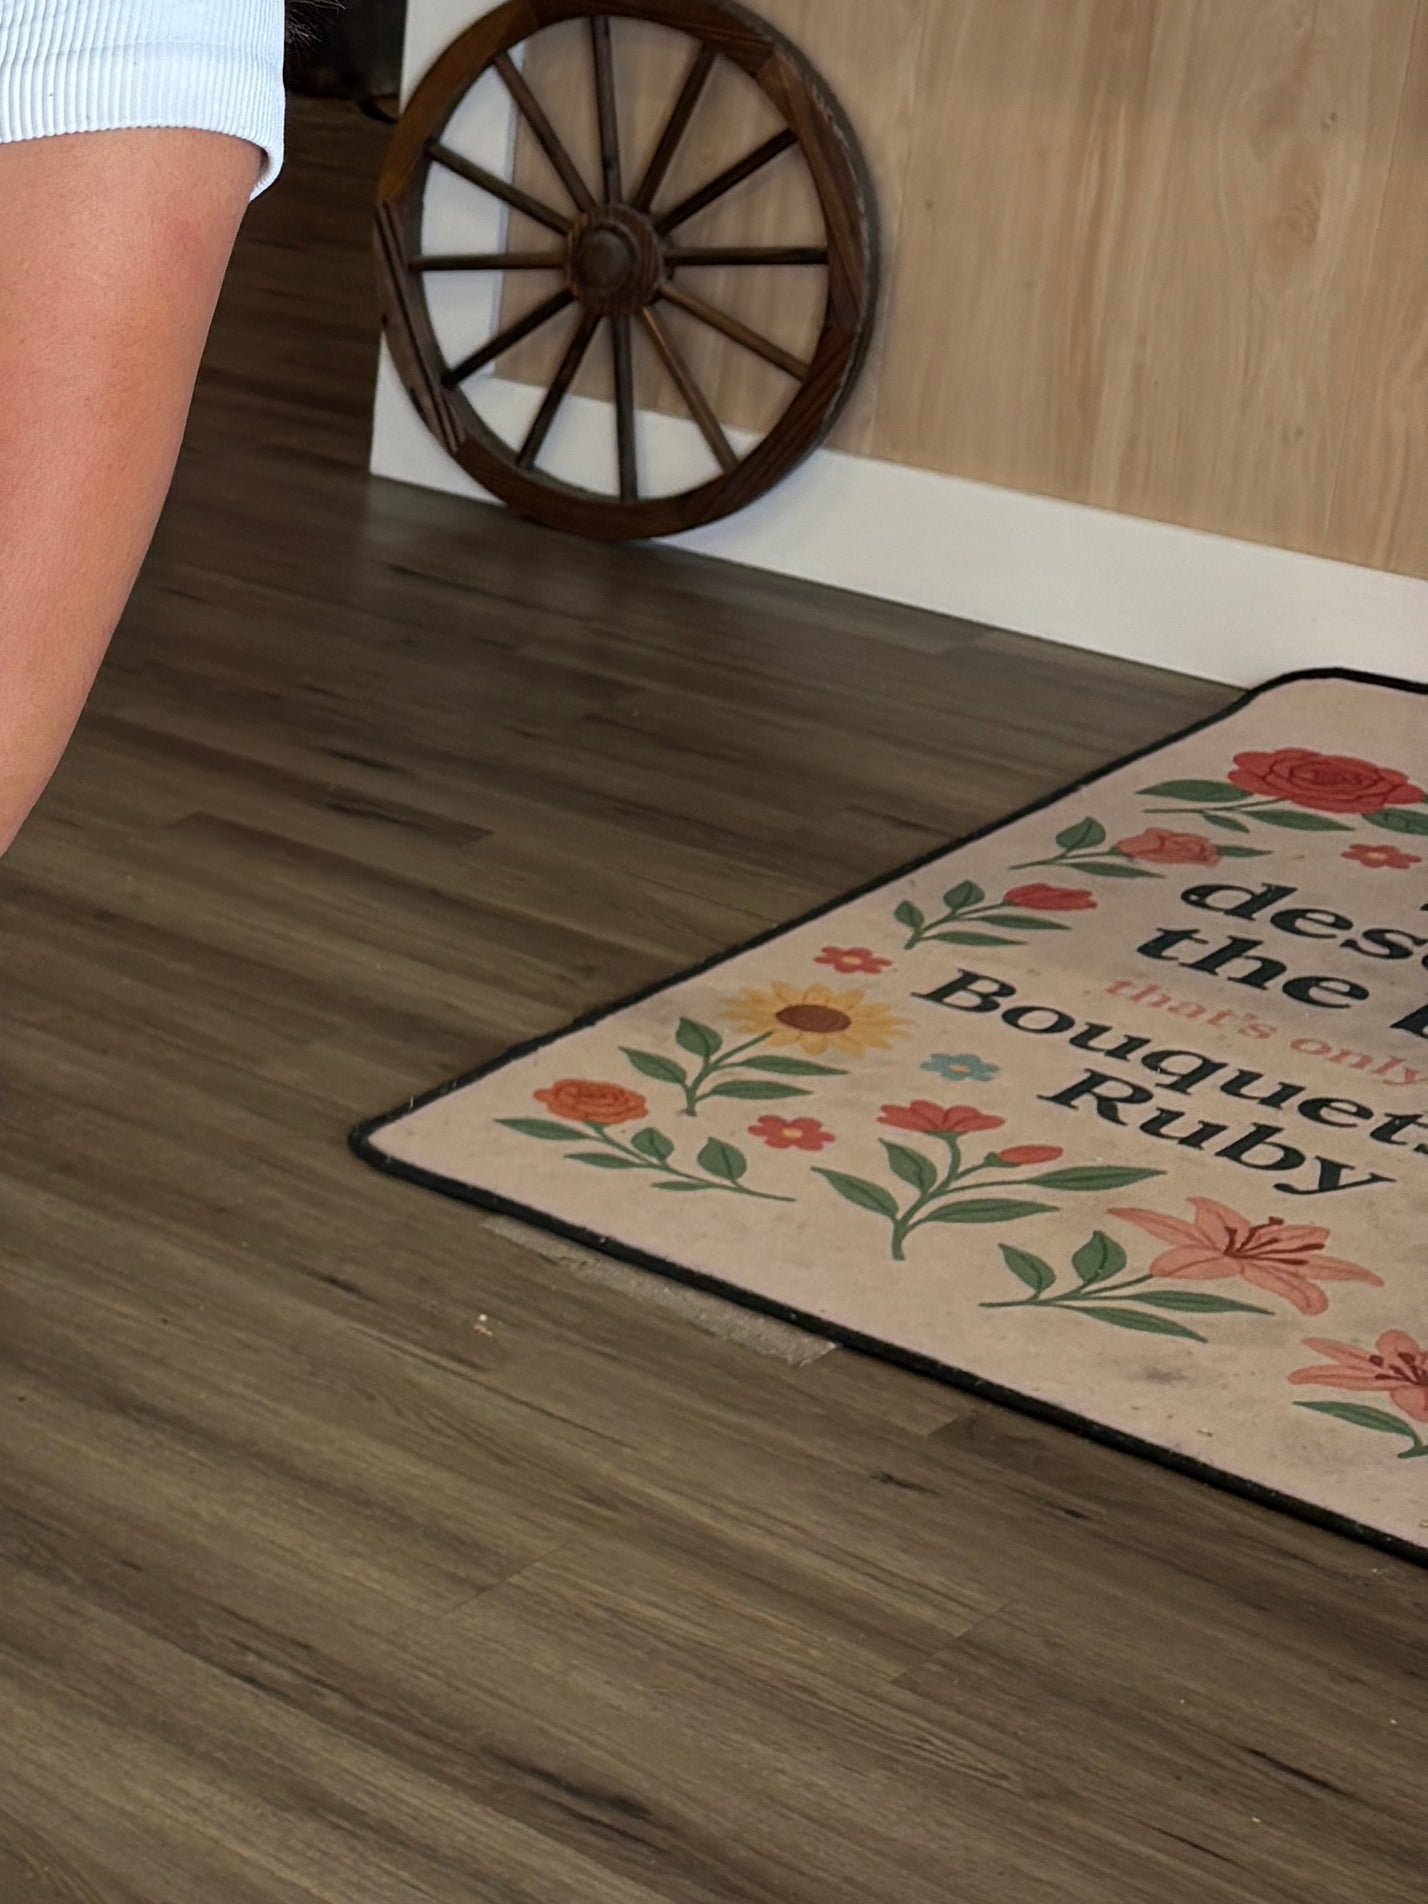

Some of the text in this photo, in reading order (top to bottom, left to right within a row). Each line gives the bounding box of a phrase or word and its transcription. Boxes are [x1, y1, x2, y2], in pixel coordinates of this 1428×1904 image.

[1136, 927, 1370, 1009] the
[1180, 882, 1428, 970] des
[1106, 978, 1428, 1087] that's only
[1037, 1068, 1399, 1196] Ruby
